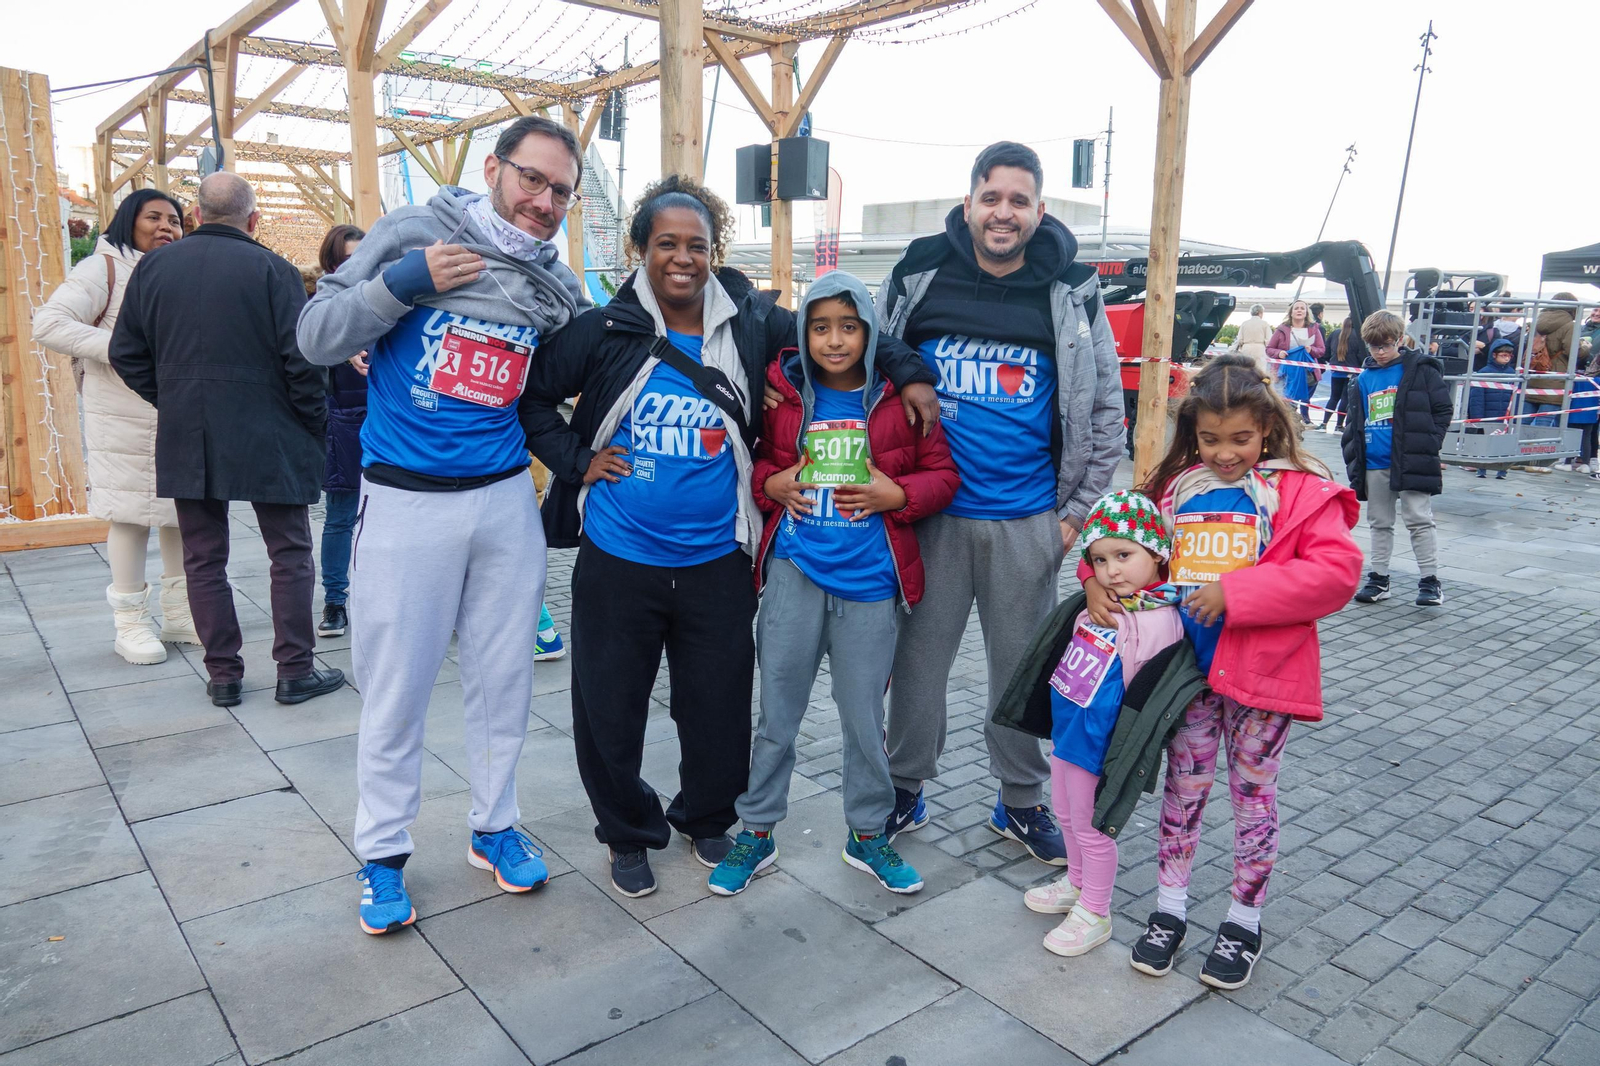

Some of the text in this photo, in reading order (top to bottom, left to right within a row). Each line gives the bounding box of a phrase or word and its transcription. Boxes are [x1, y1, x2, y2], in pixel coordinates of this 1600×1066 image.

[1176, 263, 1223, 275] mateco
[1583, 265, 1600, 274] W
[470, 350, 511, 384] 516
[451, 382, 504, 406] Alcampo
[715, 383, 735, 401] adidas
[988, 396, 1015, 404] mesma
[1376, 395, 1394, 409] 501
[814, 436, 866, 461] 5017
[811, 470, 856, 483] Alcampo
[823, 520, 850, 528] mesma
[851, 520, 870, 528] meta
[1182, 531, 1249, 559] 3005
[1176, 566, 1221, 582] Alcam
[1061, 641, 1100, 678] 007
